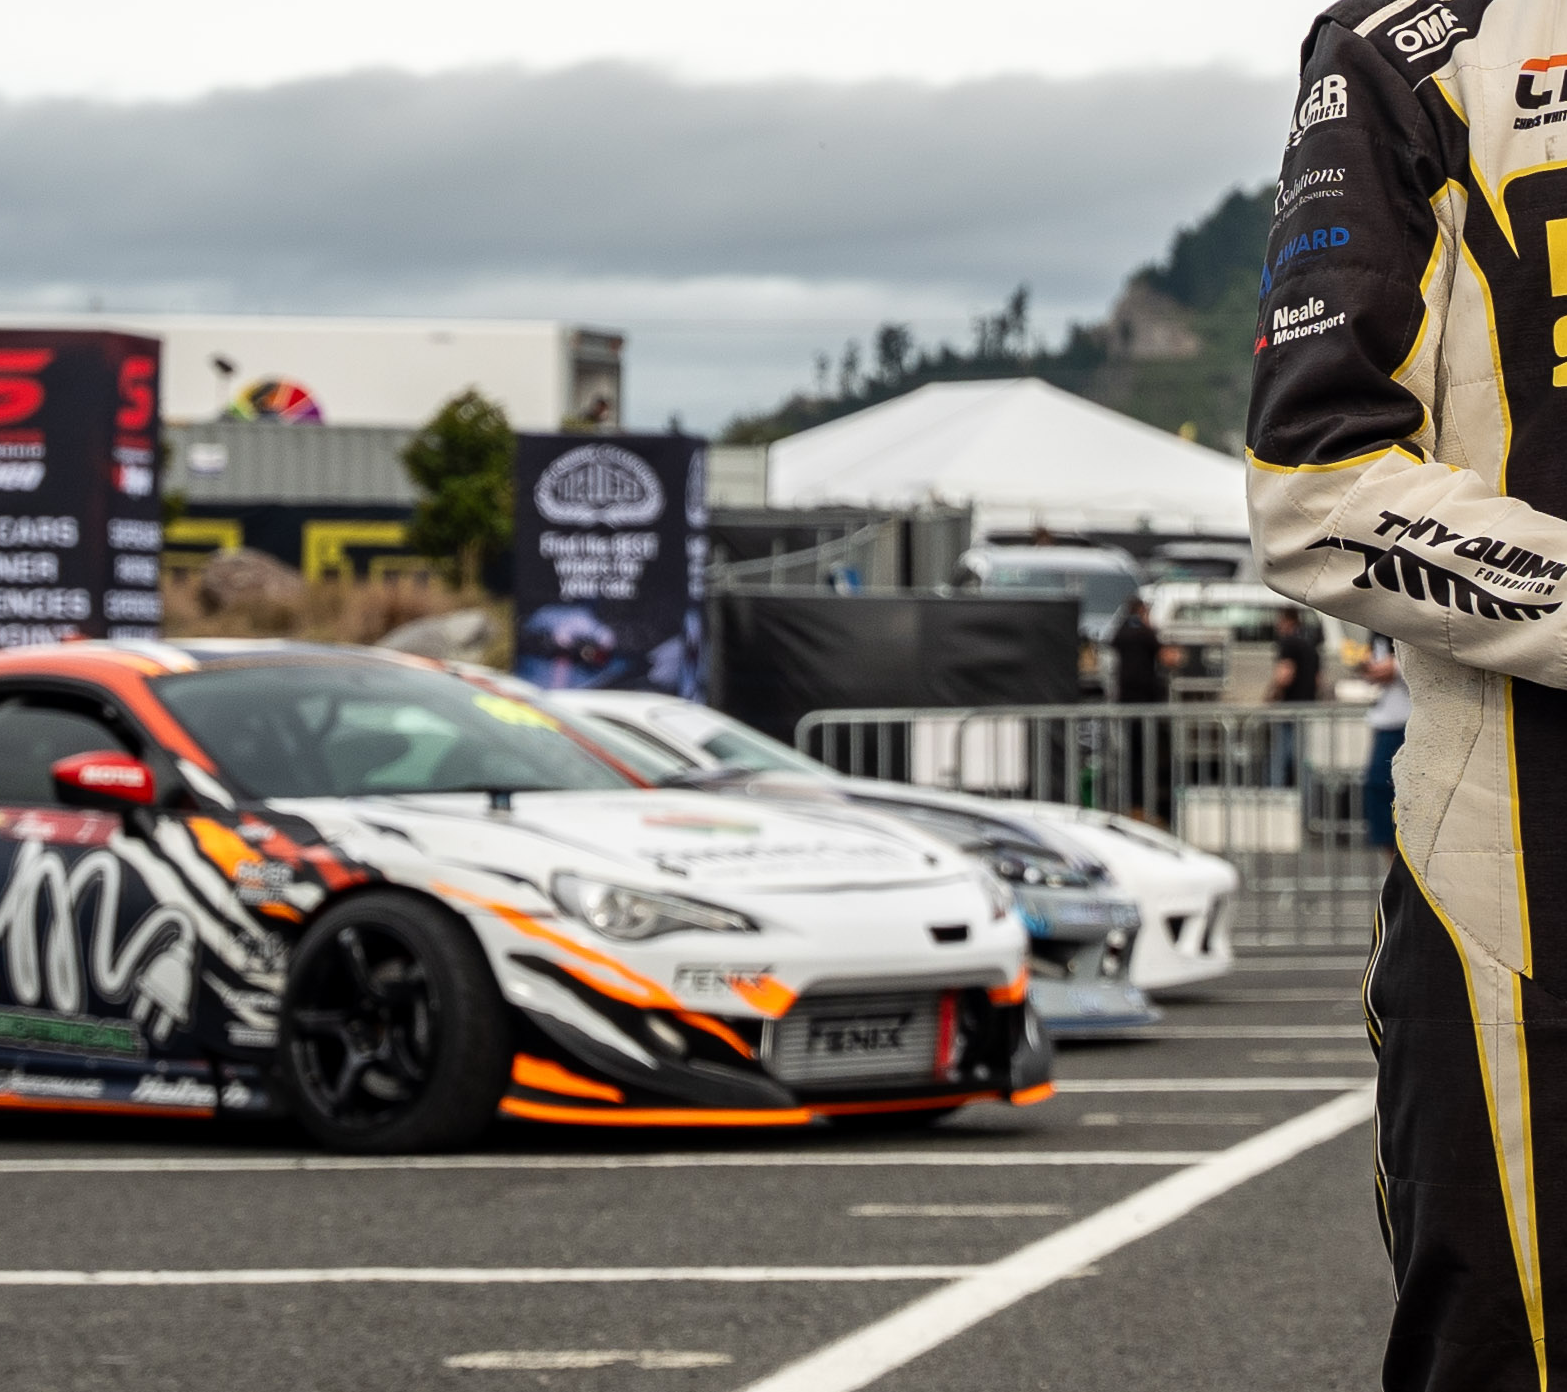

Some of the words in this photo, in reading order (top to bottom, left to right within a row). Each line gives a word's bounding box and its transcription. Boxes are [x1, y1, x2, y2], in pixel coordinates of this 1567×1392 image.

[1513, 116, 1541, 130] CHRIS
[1276, 226, 1351, 266] AWARD
[1272, 297, 1325, 330] Neale
[1273, 312, 1346, 346] Motorsport
[1474, 567, 1555, 596] FOUNDATION
[674, 963, 777, 1000] FENIX
[805, 1012, 913, 1054] FENIX
